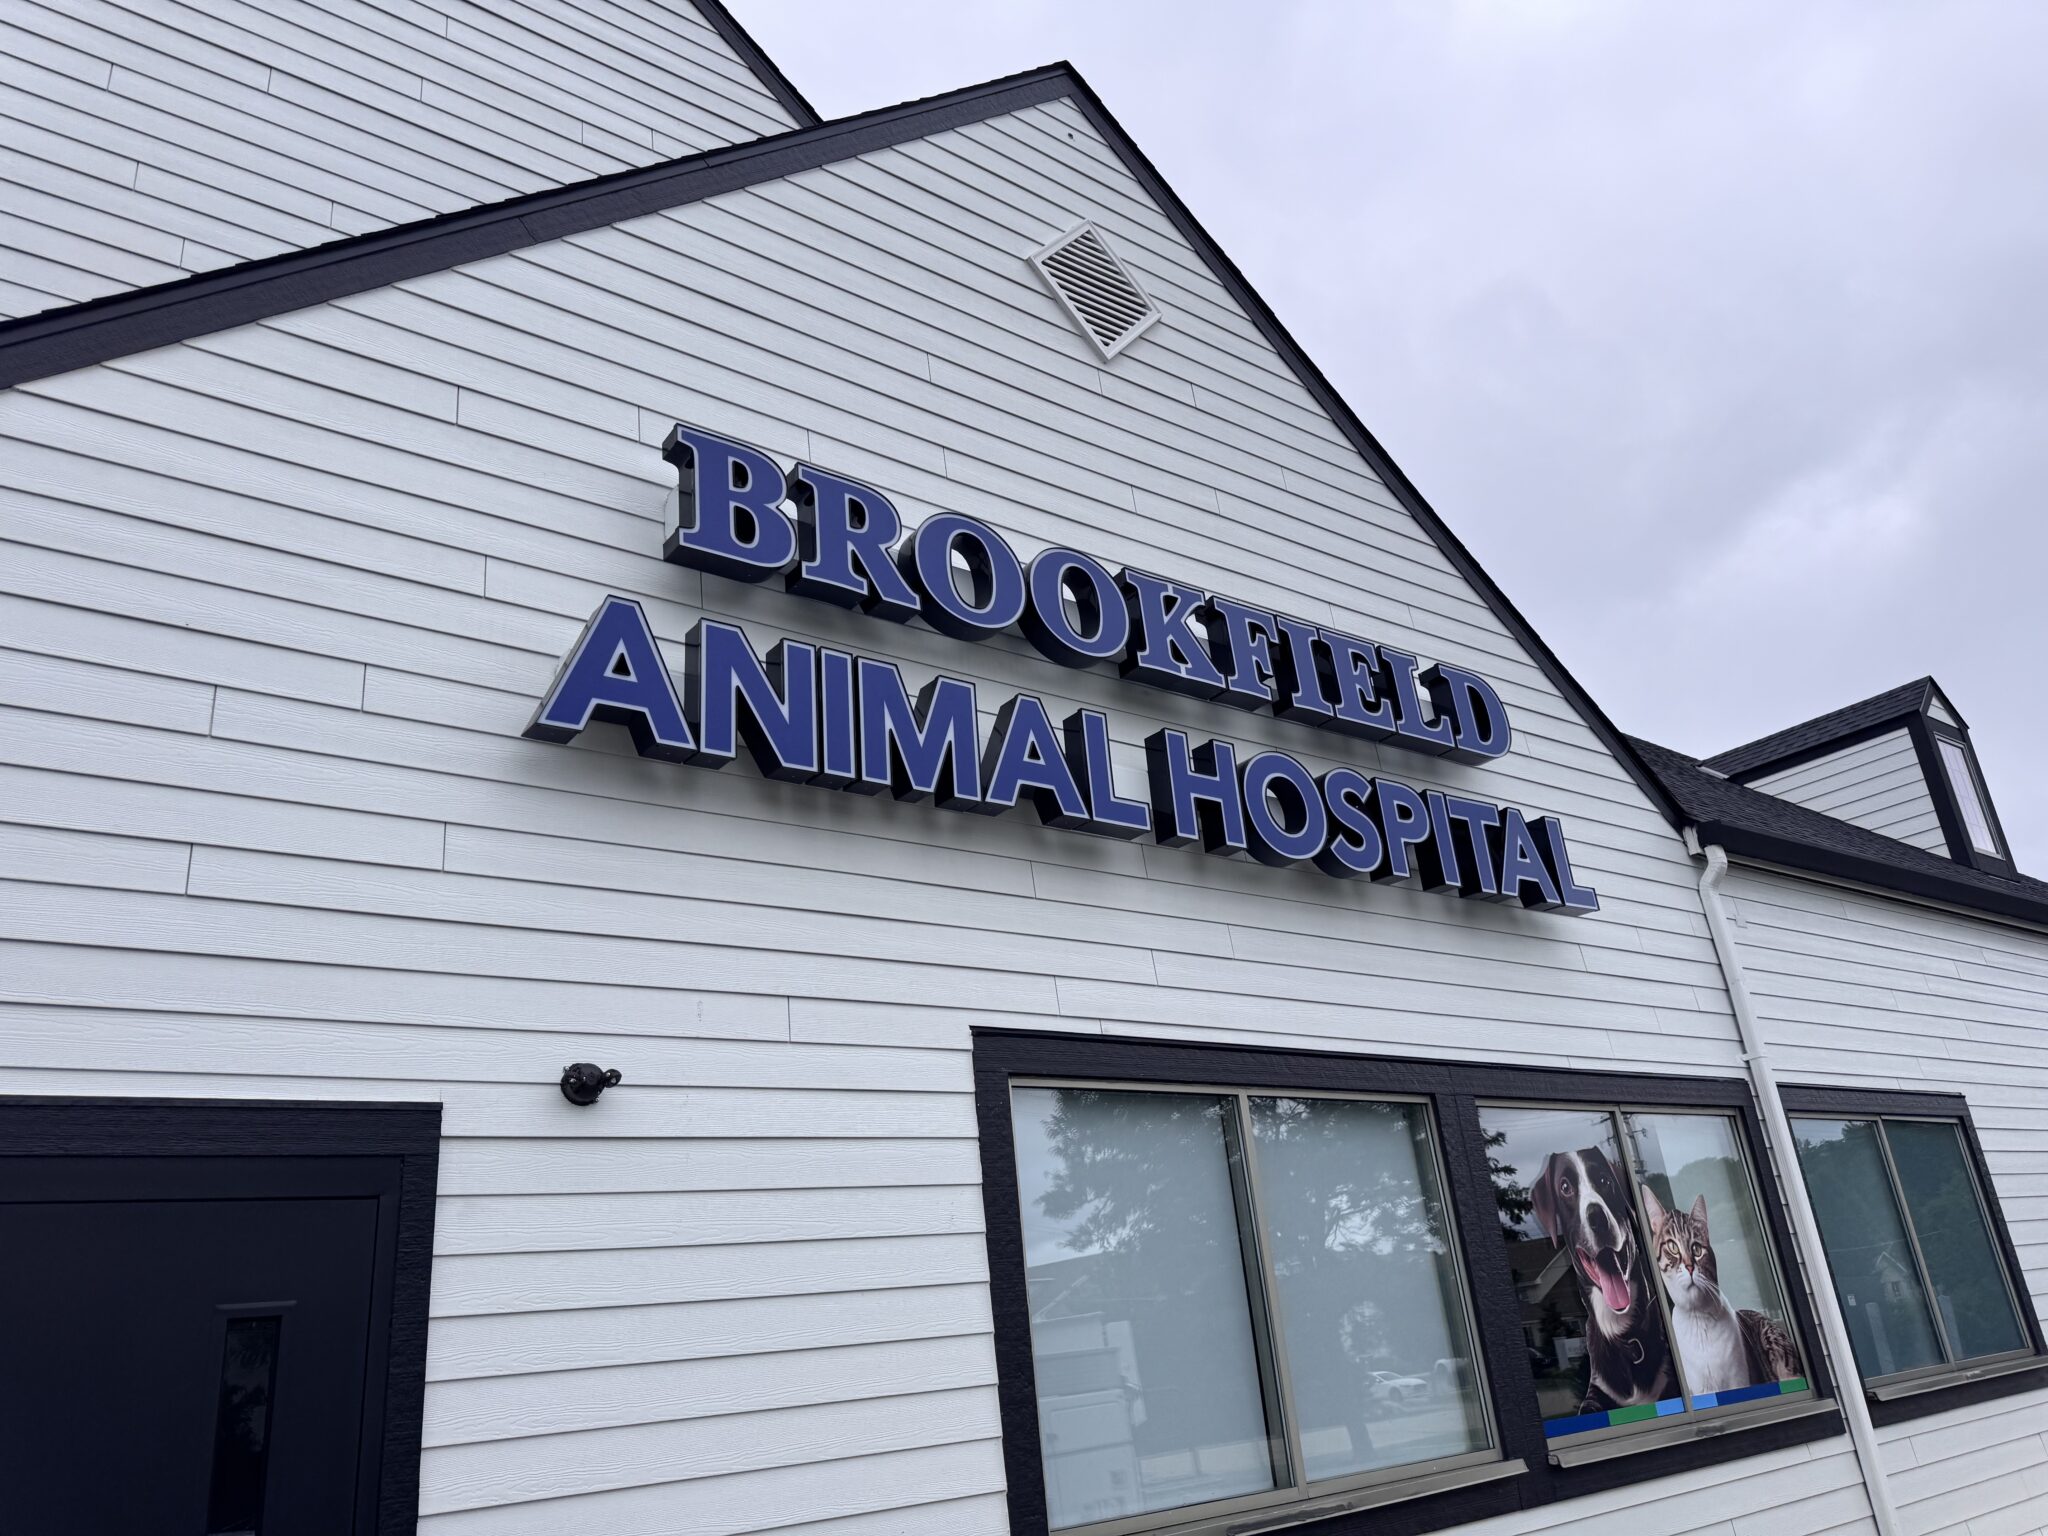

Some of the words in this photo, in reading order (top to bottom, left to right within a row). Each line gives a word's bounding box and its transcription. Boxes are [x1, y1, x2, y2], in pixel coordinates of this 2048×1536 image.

[537, 594, 1152, 832] ANIMAL
[1164, 728, 1600, 912] HOSPITAL
[676, 424, 1512, 759] BROOKFIELD
